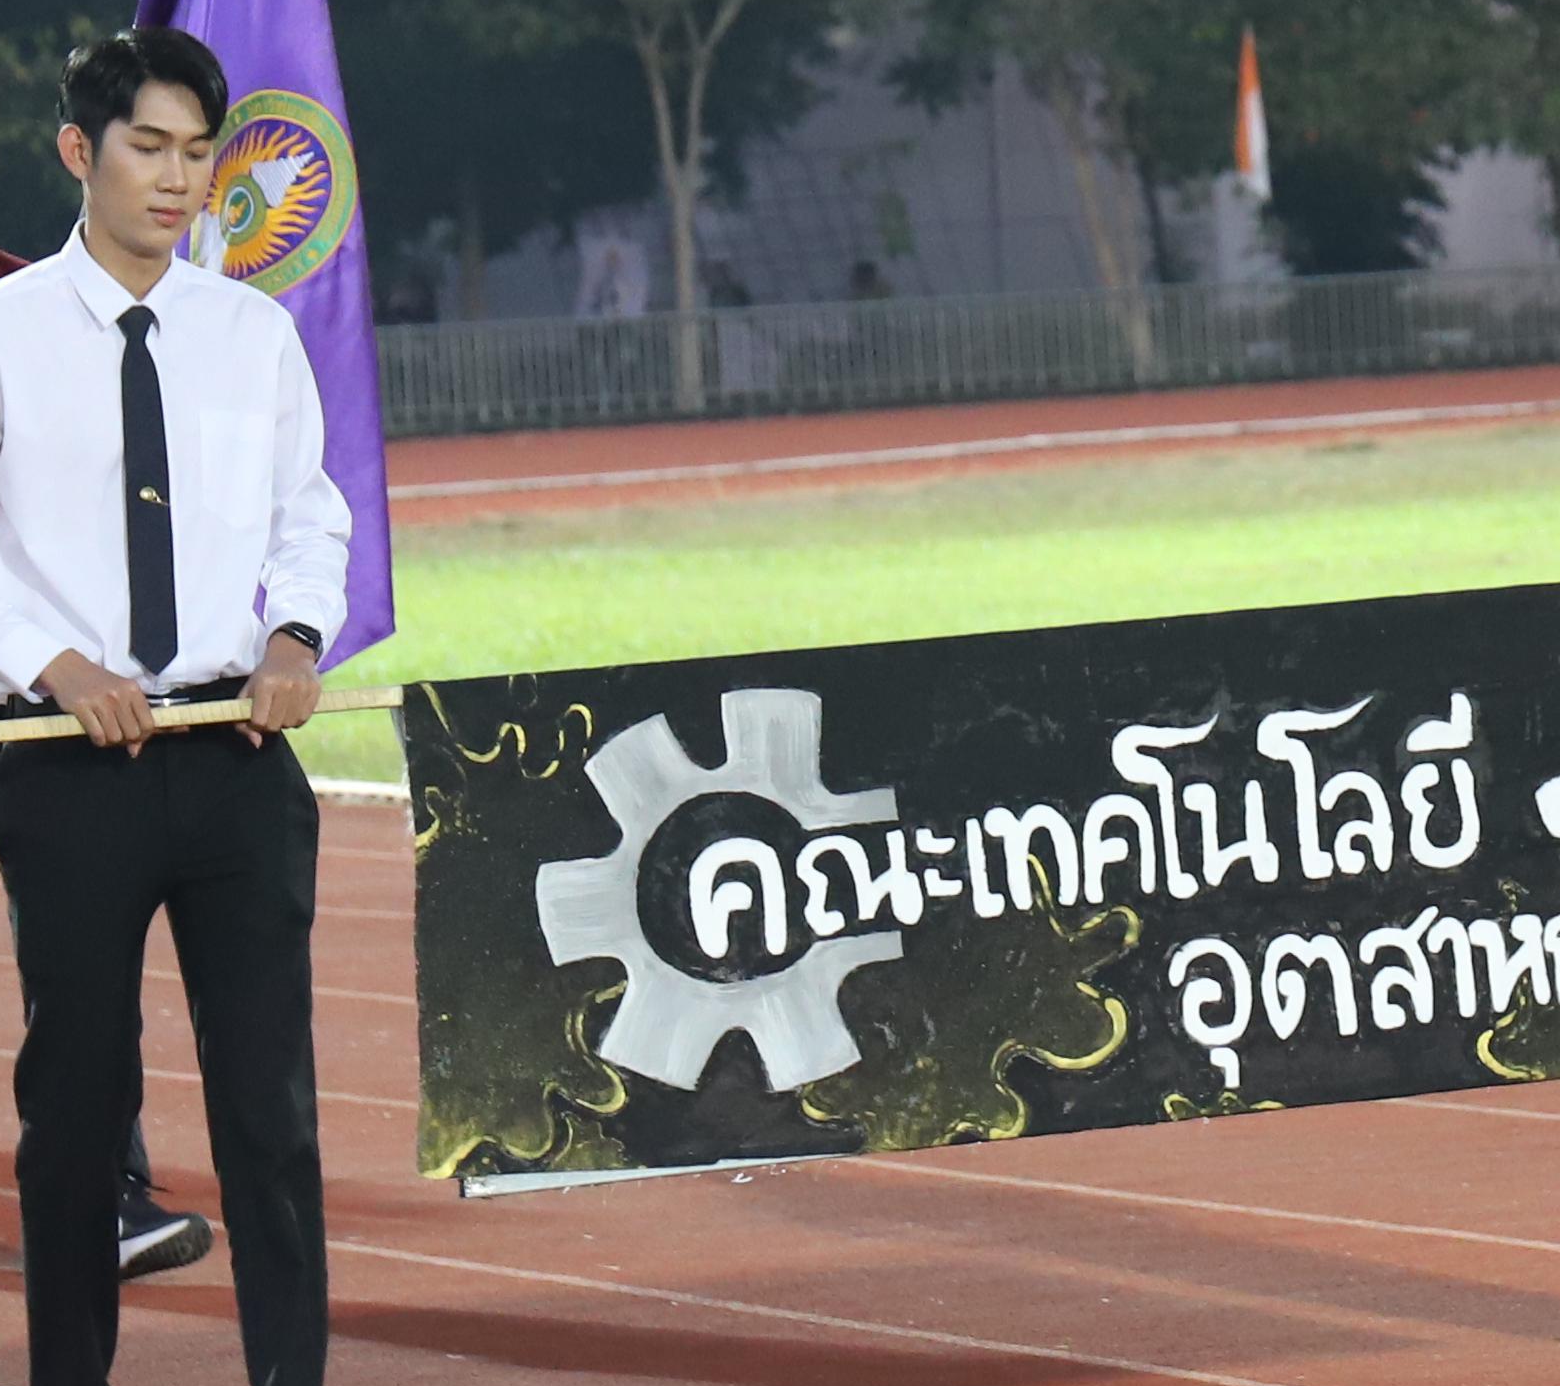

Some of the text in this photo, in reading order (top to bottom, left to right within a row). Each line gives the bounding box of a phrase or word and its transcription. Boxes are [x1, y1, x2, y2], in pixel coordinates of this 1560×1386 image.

[687, 691, 1482, 960] คณะเทคโนโลยี
